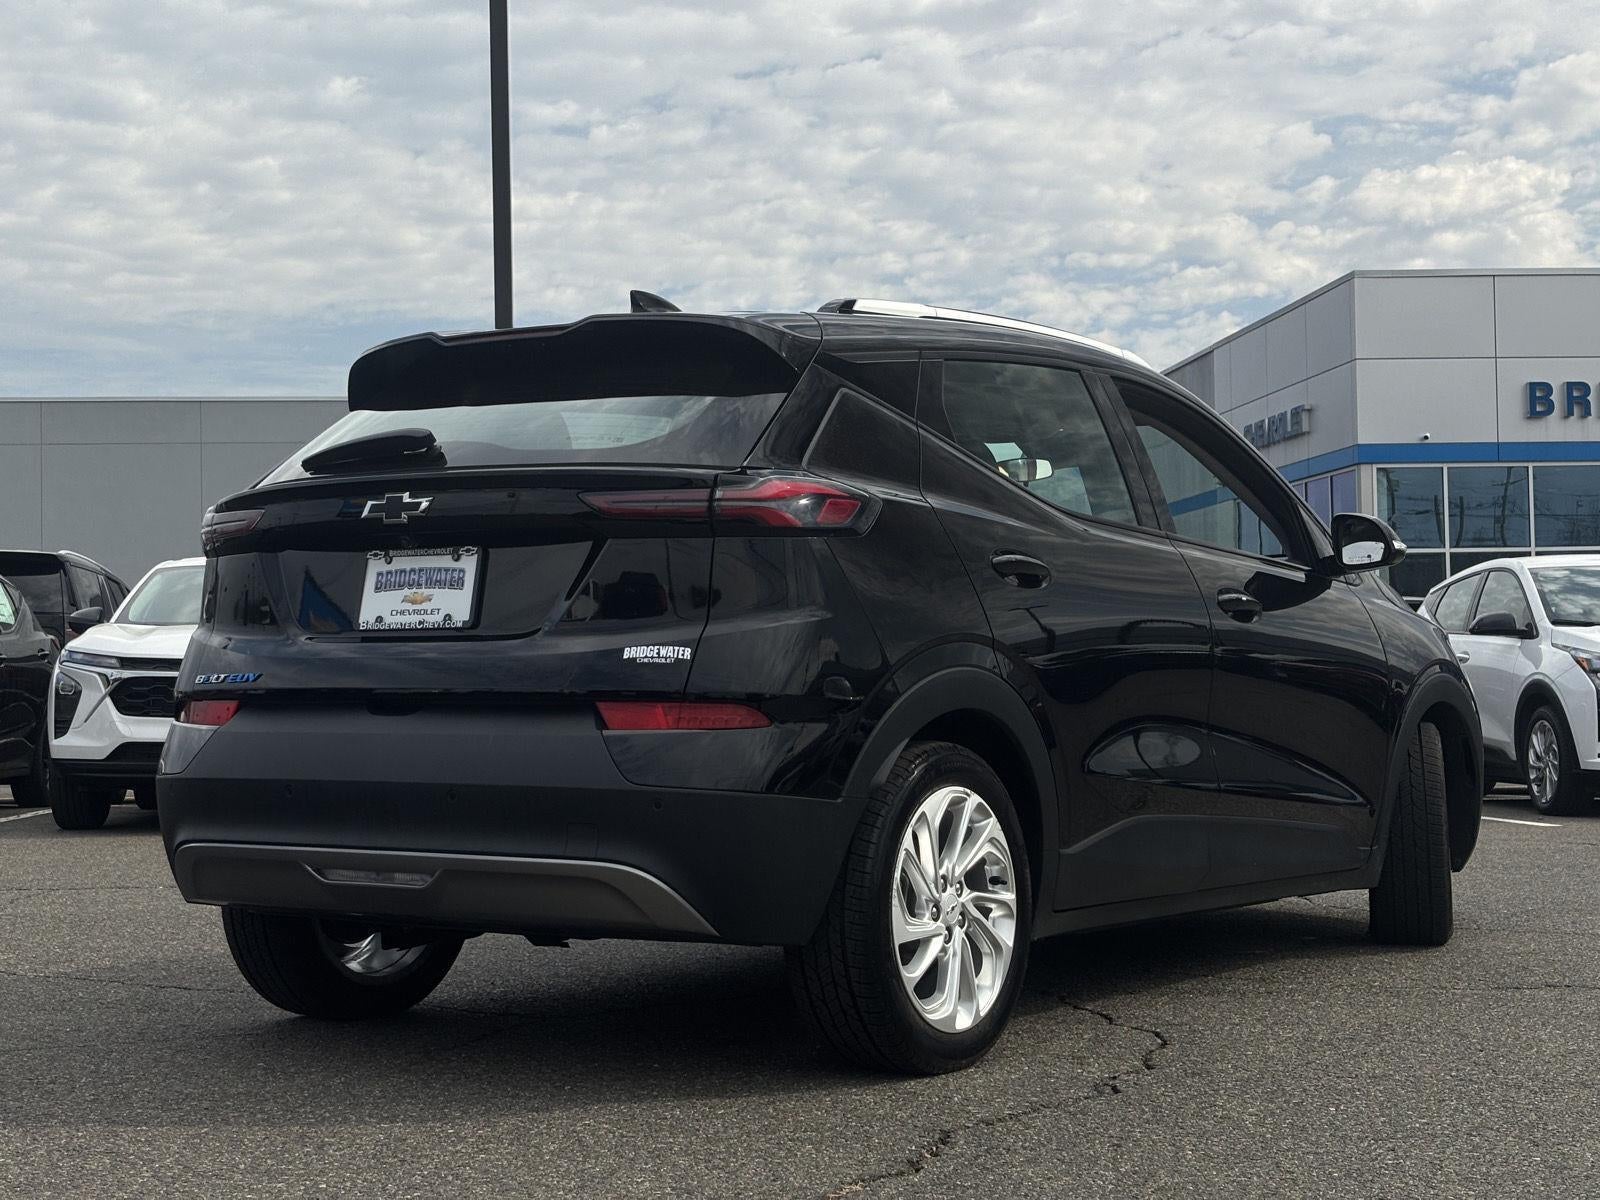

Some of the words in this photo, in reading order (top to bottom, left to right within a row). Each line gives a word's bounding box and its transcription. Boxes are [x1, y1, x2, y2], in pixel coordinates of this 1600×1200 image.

[374, 567, 466, 593] BRIDGEWATER
[390, 608, 441, 617] CHEVROLET
[623, 645, 692, 660] BRIDGEWATER
